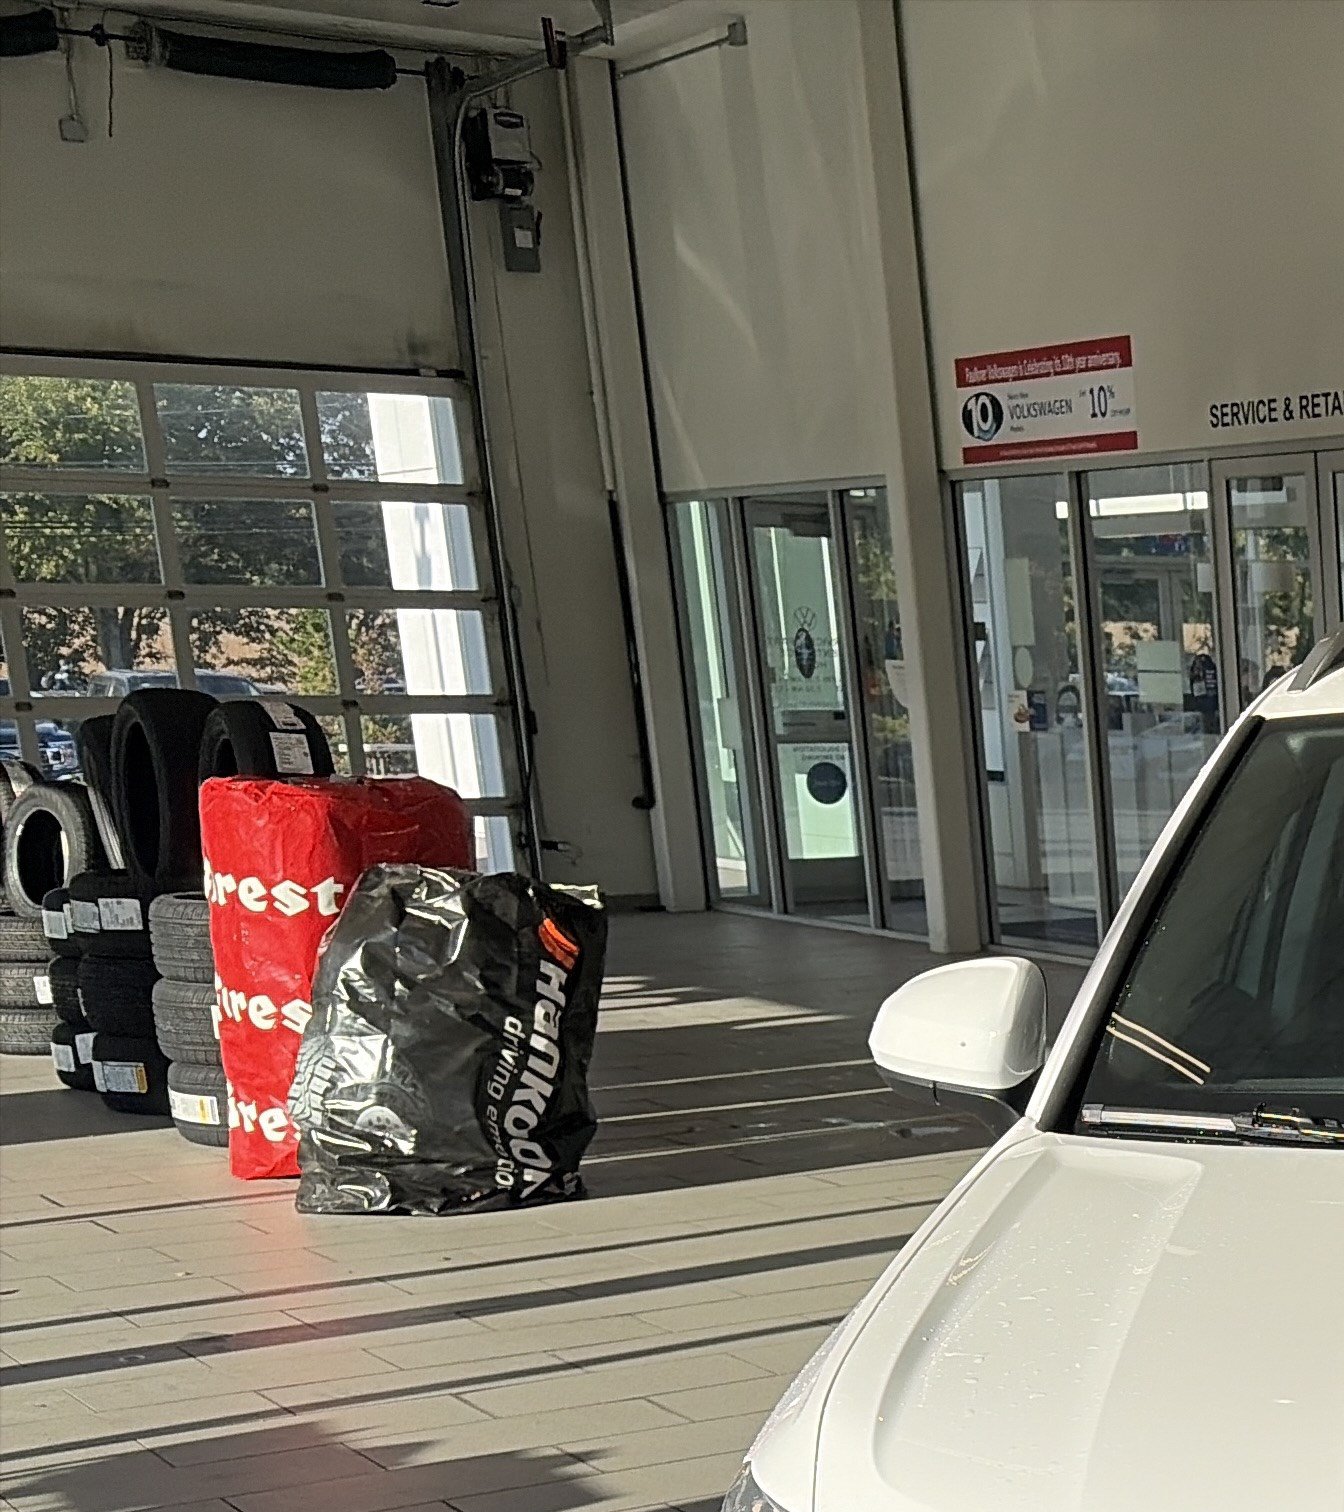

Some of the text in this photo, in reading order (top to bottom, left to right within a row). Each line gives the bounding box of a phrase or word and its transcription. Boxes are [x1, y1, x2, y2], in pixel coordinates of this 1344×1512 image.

[1008, 398, 1073, 421] VOLKSWAGEN
[1209, 397, 1278, 429] SERVICE
[1283, 396, 1294, 422] &
[203, 856, 344, 916] irest
[487, 1015, 526, 1101] driving
[227, 1078, 301, 1142] ire
